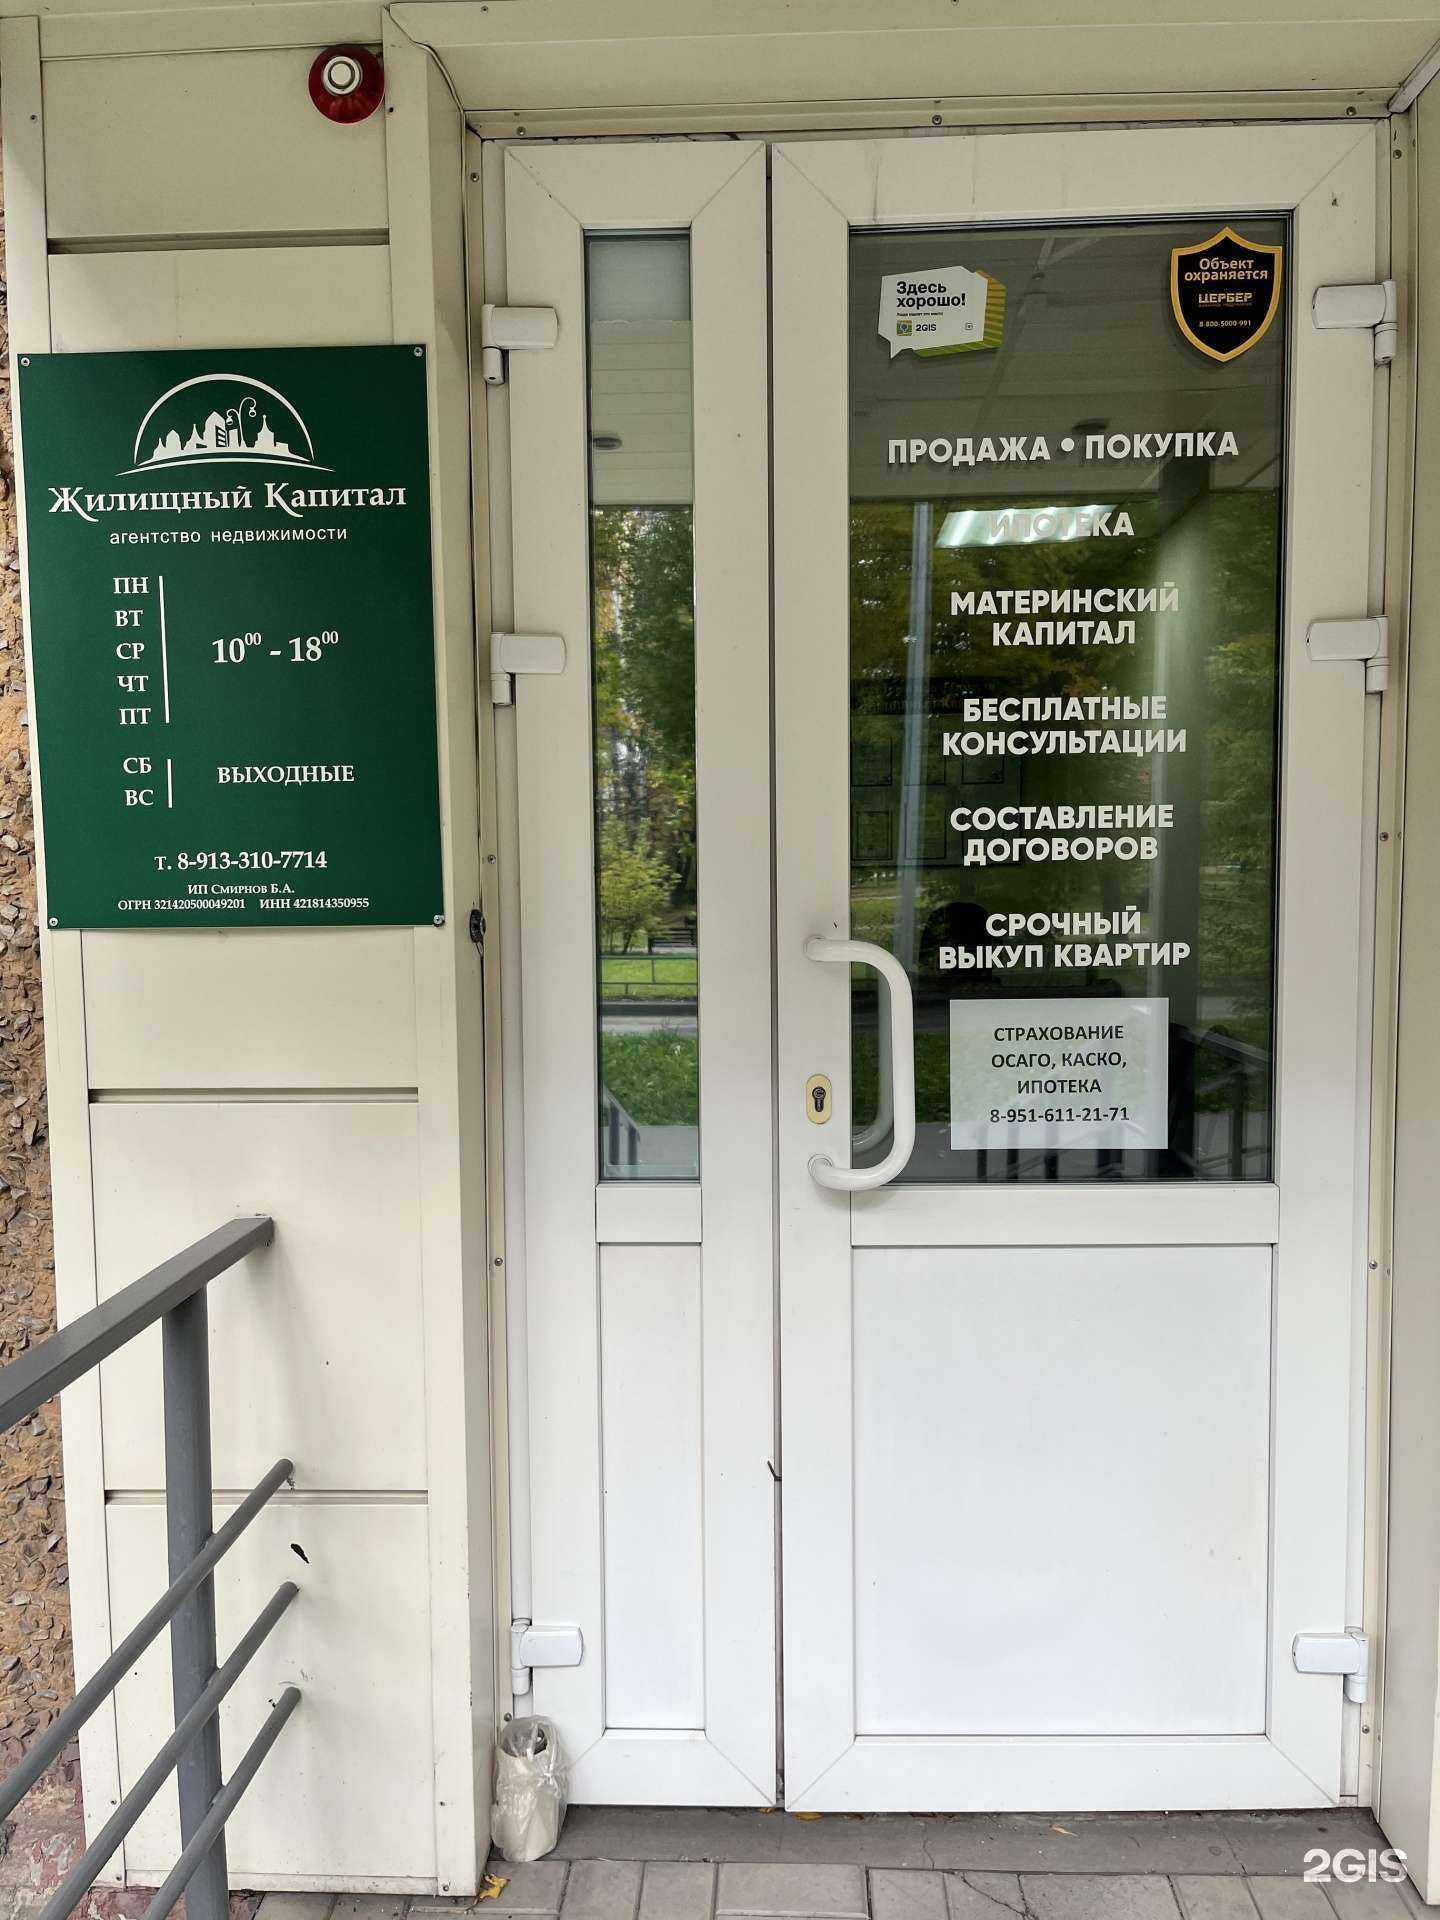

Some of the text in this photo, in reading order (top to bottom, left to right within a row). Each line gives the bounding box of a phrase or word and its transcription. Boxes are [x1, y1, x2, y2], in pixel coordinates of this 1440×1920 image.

[1200, 257, 1254, 269] Объект
[1185, 271, 1267, 283] охраняется
[897, 281, 946, 296] Здесь
[897, 293, 966, 309] хорошо!
[1199, 293, 1252, 303] ЦЕРБЕР
[915, 323, 937, 332] 2GIS
[889, 432, 1238, 466] ПРОДАЖА ПОКУПКА
[48, 483, 406, 522] Жилищный Капитал
[991, 512, 1134, 537] ИПОТЕКА
[110, 529, 346, 544] агентство недвижимости
[113, 577, 149, 593] ПН
[950, 582, 1179, 616] МАТЕРИНСКИЙ
[115, 610, 143, 626] ВТ
[993, 621, 1135, 645] КАПИТАЛ
[116, 643, 144, 659] СР
[117, 676, 148, 691] ЧТ
[120, 708, 151, 724] ПТ
[963, 695, 1167, 722] БЕСПЛАТНЫЕ
[943, 728, 1187, 757] КОНСУЛЬТАЦИИ
[123, 758, 151, 773] СБ
[217, 766, 354, 786] ВЫХОДНЫЕ
[125, 790, 153, 806] ВС
[951, 804, 1173, 832] СОСТАВЛЕНИЕ
[964, 837, 1159, 866] ДОГОВОРОВ
[178, 851, 327, 869] 8-913-310-7714
[188, 885, 208, 894] ИП
[271, 884, 294, 893] Б.А.
[118, 898, 369, 910] ОГРН 321420500049201 ИНН 421814350955
[985, 905, 1141, 936] СРОЧНЫЙ
[940, 943, 1190, 969] ВЫКУП КВАРТИР
[994, 1026, 1123, 1041] СТРАХОВАНИЕ
[992, 1052, 1126, 1069] ОСАГО, КАСКО,
[1017, 1079, 1102, 1094] ИПОТЕКА
[991, 1107, 1129, 1122] 8-951-611-21-71
